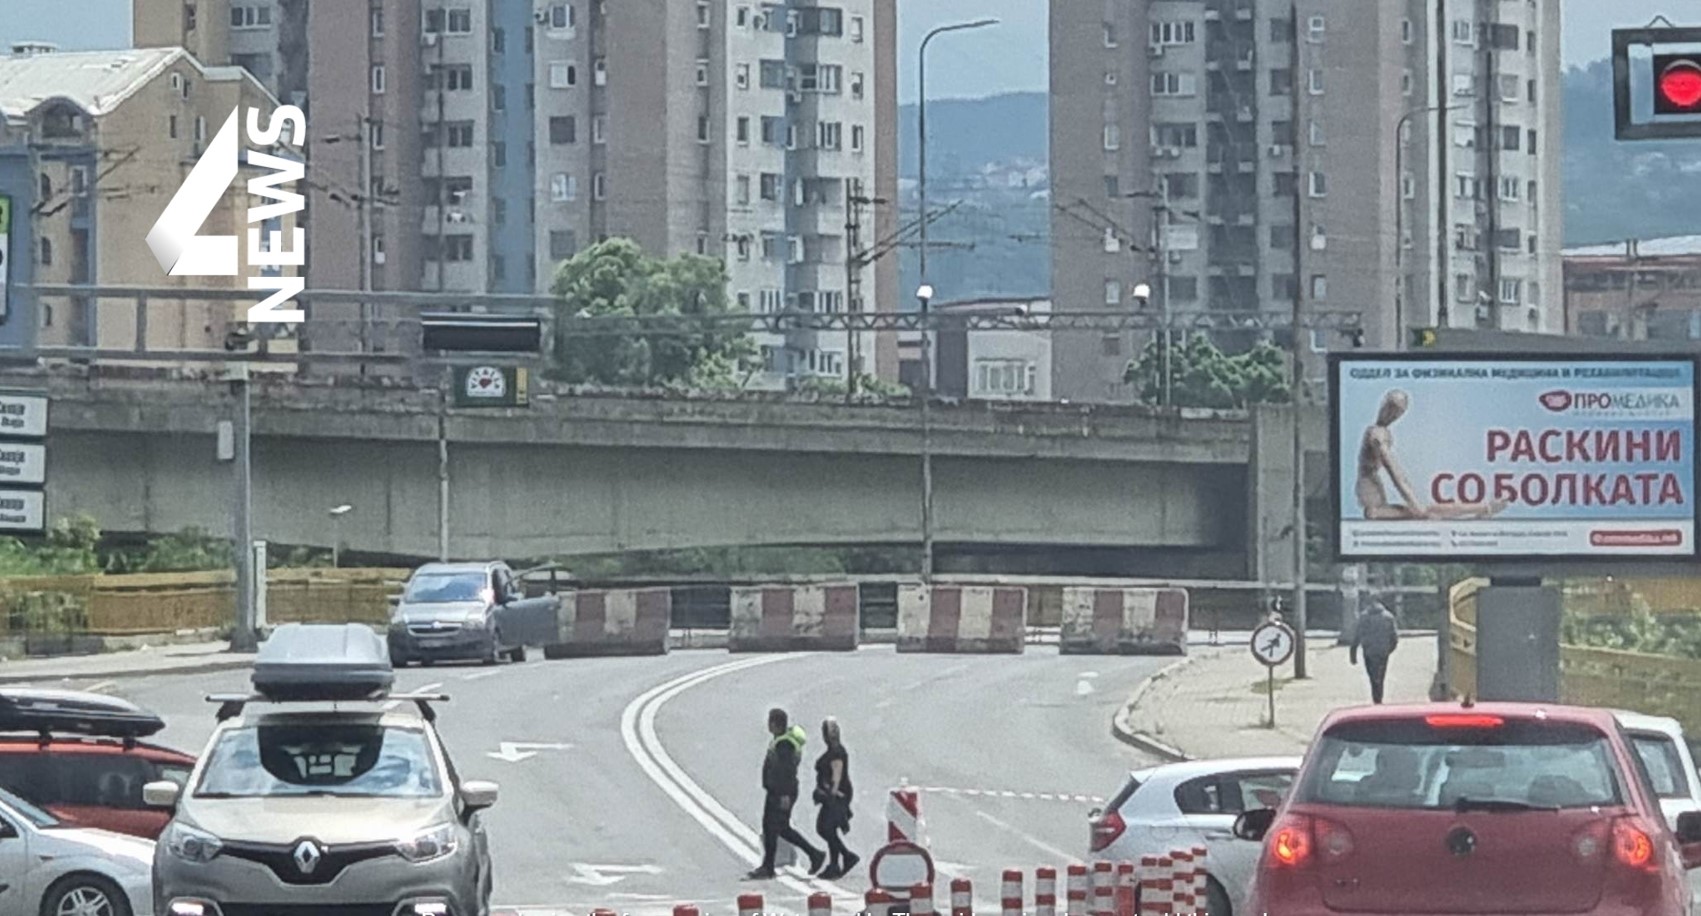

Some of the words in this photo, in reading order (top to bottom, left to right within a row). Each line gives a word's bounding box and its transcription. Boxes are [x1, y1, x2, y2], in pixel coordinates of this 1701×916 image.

[1394, 367, 1410, 379] ЗА
[1563, 367, 1571, 378] И
[1574, 392, 1679, 410] ПРОМЕДИКА
[1487, 429, 1682, 463] РАСКИНИ
[1431, 473, 1486, 505] СО
[1494, 473, 1684, 506] БОЛКАТА
